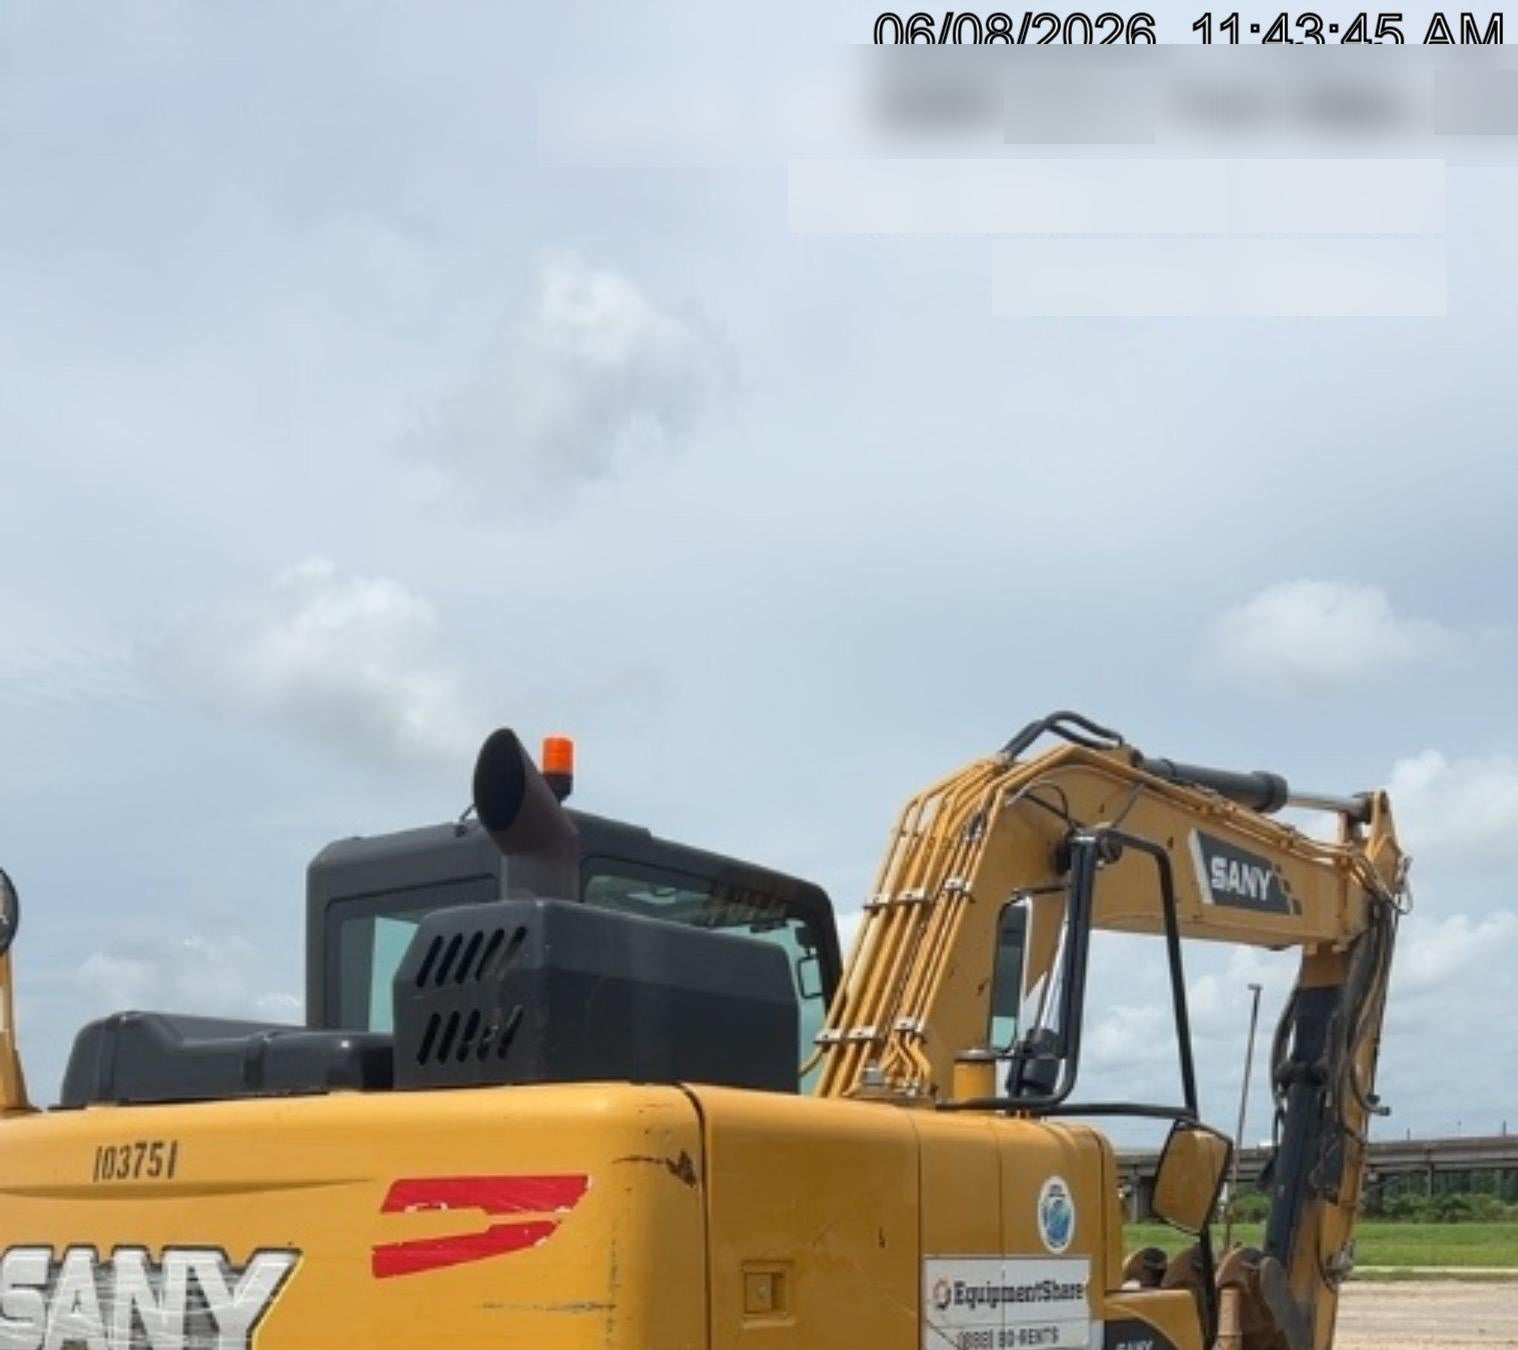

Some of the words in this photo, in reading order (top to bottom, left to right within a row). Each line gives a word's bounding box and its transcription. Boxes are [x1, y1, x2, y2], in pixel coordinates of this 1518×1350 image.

[1211, 856, 1272, 901] SANY
[92, 1140, 178, 1183] 103751
[954, 1280, 1083, 1309] EquipmentShare
